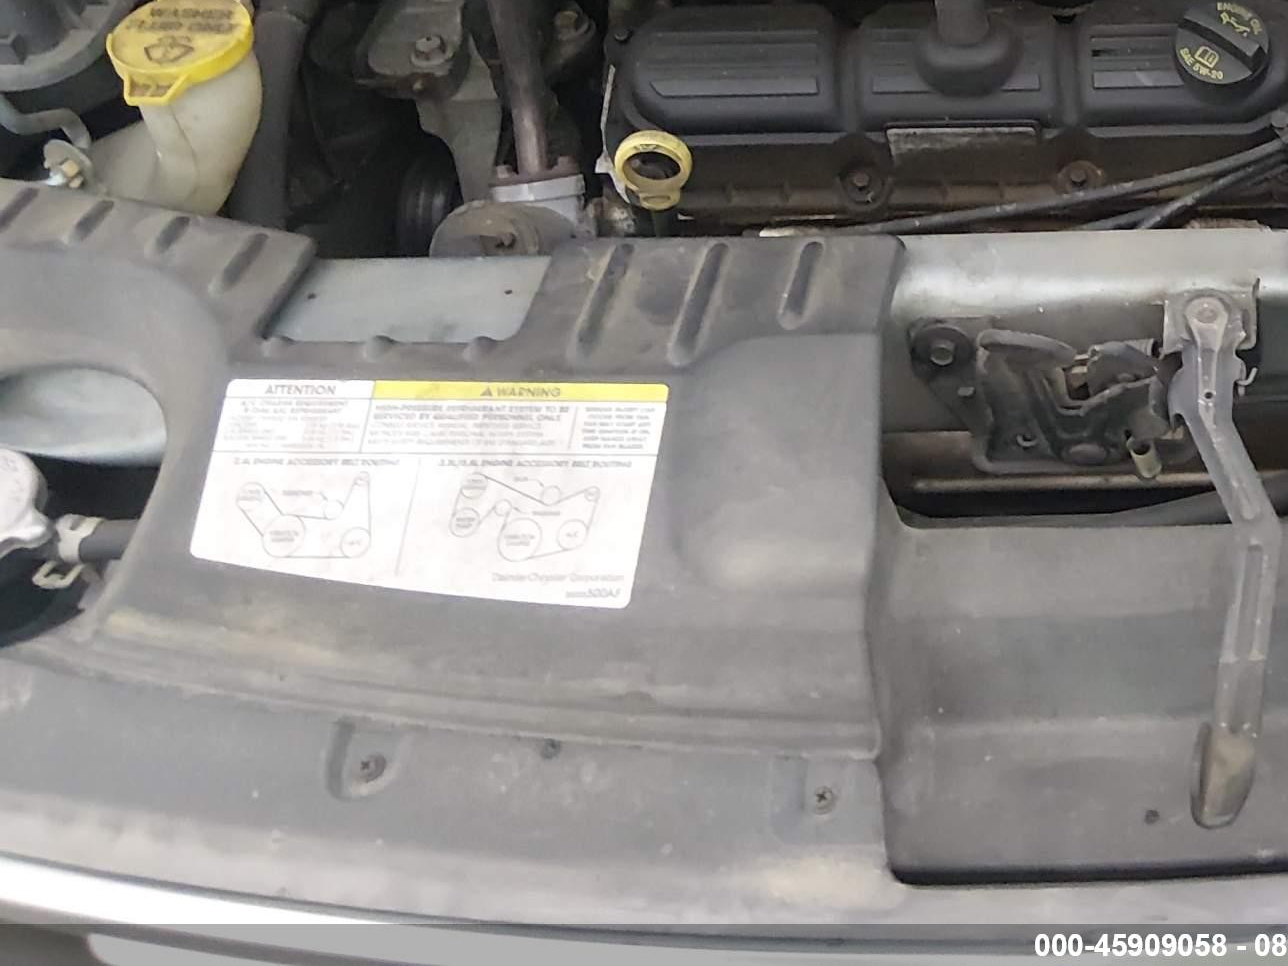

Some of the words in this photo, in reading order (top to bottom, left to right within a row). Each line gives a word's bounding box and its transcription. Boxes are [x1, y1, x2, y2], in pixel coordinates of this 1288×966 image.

[150, 7, 235, 19] WASHER
[126, 19, 184, 33] FLUID
[187, 22, 236, 35] ONLY
[1249, 18, 1263, 35] OIL
[1179, 47, 1196, 66] SAE
[1192, 62, 1224, 81] 5W-20
[264, 384, 337, 395] ATTENTION
[497, 386, 562, 398] WARNING
